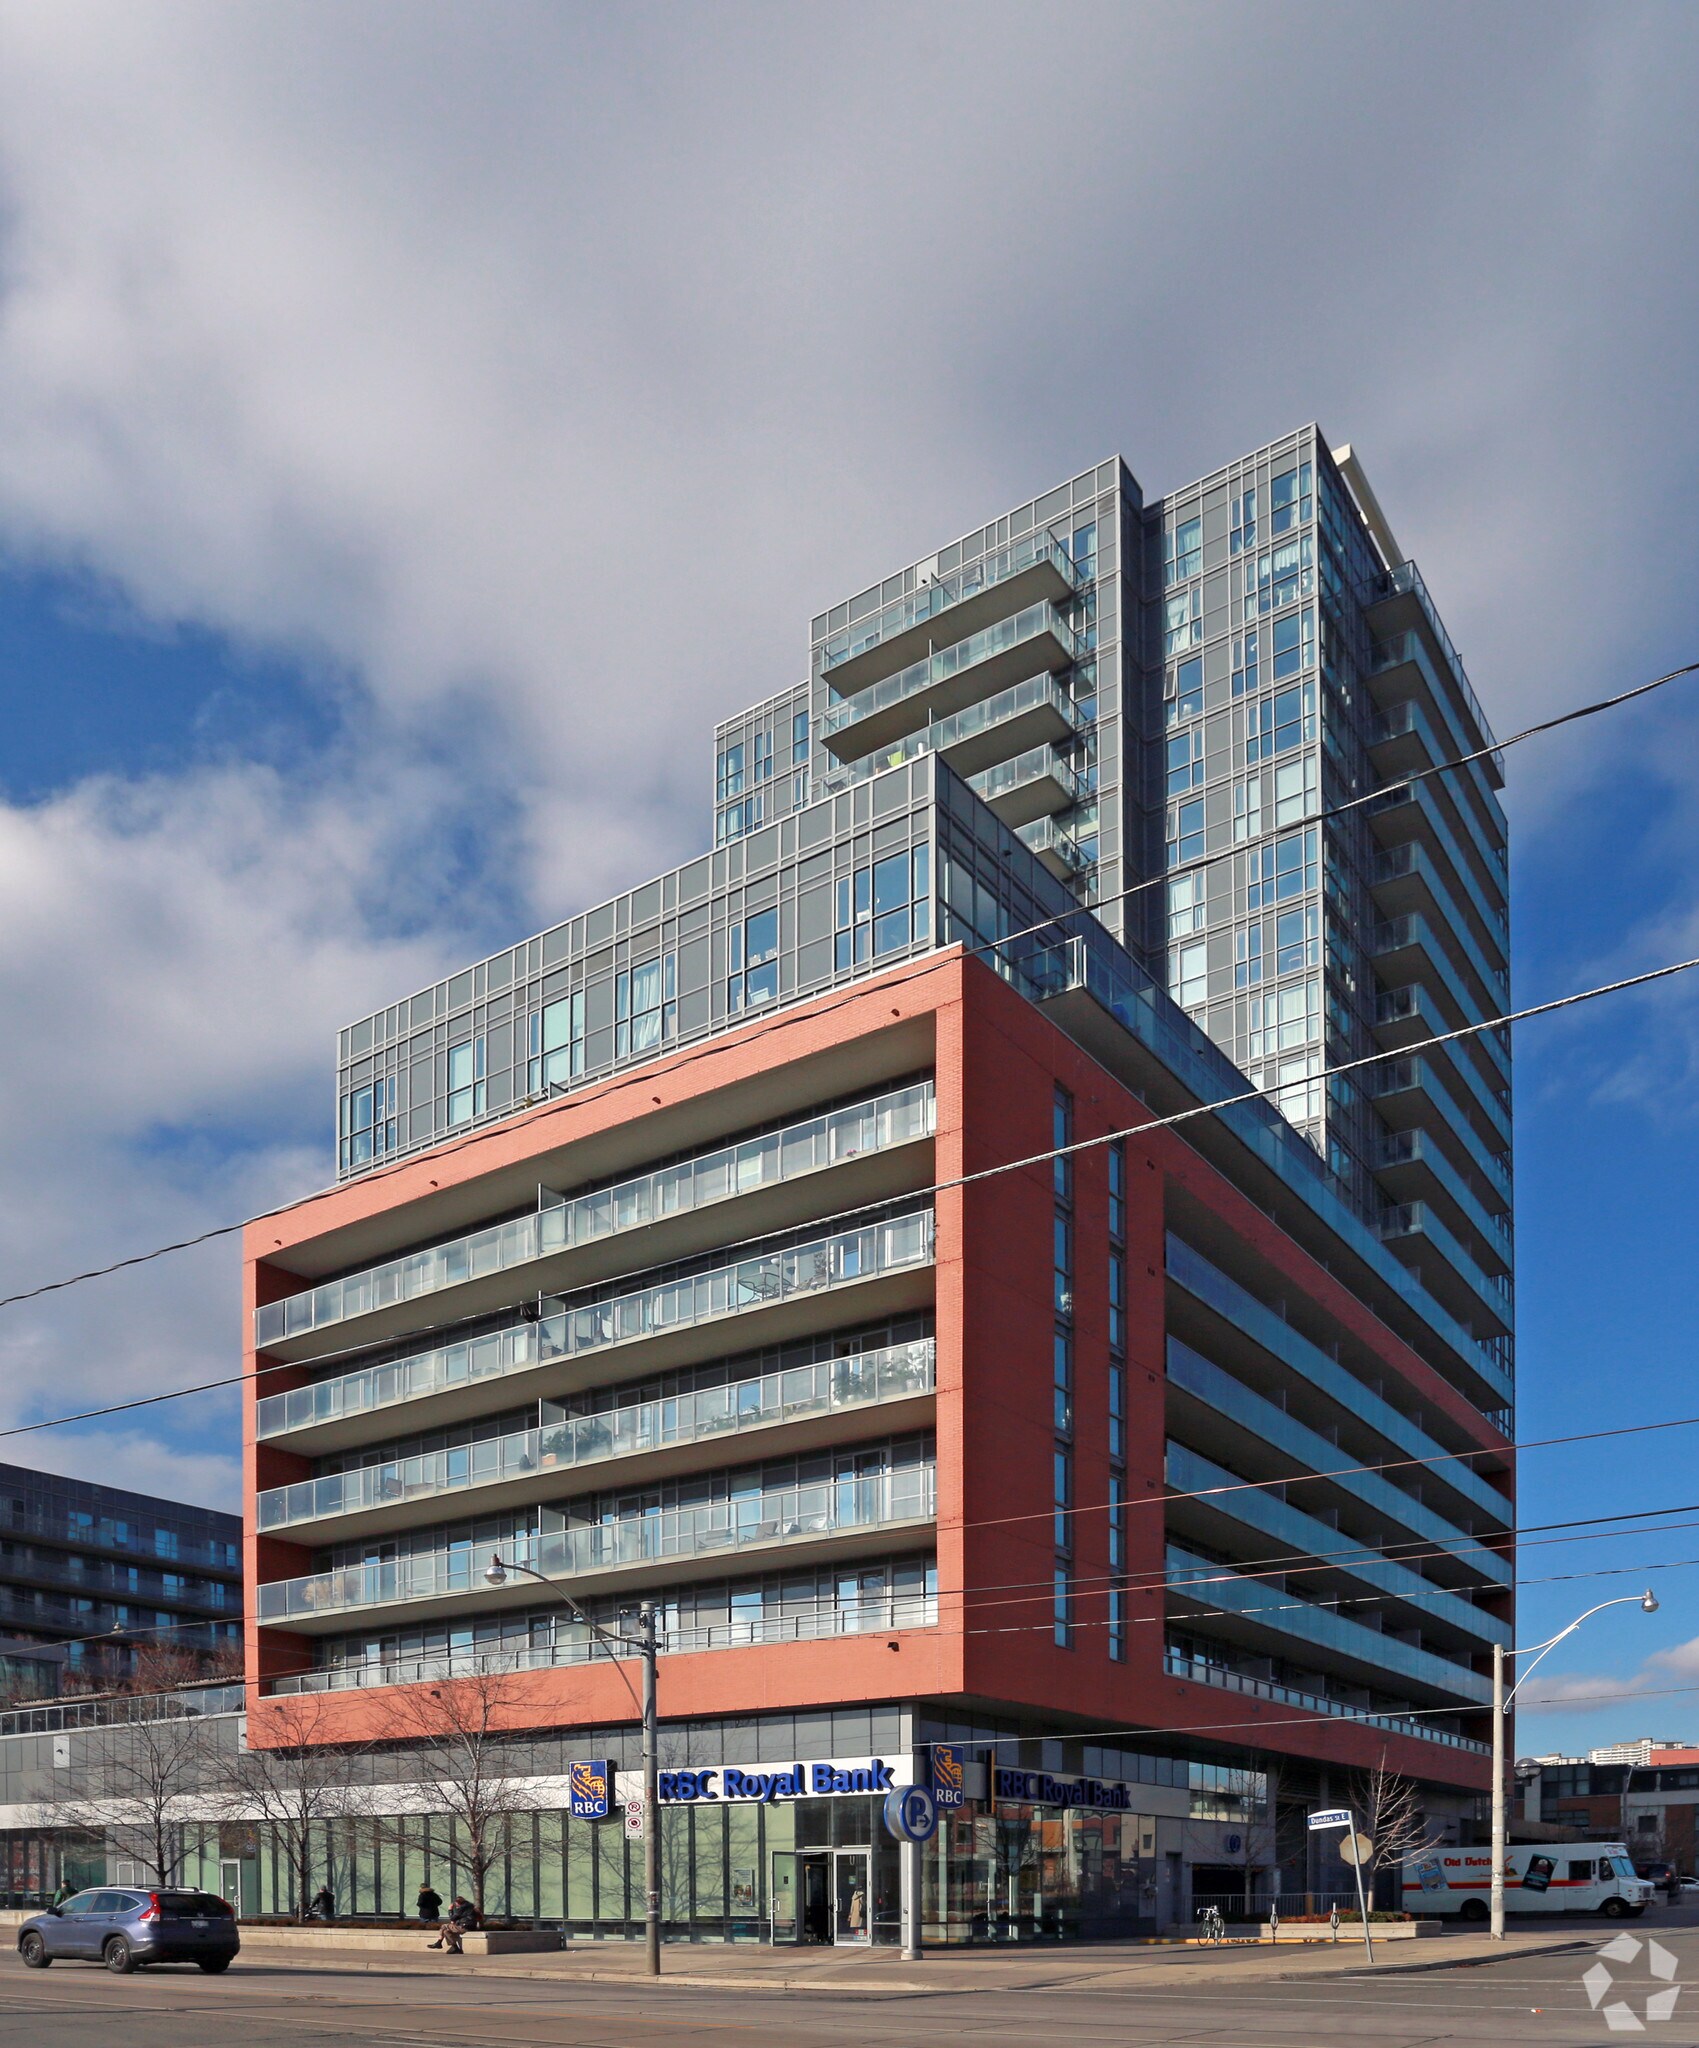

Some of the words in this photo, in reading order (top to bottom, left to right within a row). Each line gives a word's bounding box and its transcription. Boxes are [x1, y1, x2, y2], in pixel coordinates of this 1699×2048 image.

[659, 1770, 718, 1801] RBC
[723, 1763, 804, 1803] Royal
[812, 1759, 895, 1793] Bank
[1000, 1769, 1039, 1800] RBC
[1042, 1774, 1089, 1807] Royal
[1093, 1781, 1131, 1808] Bank
[936, 1788, 961, 1804] RBC
[574, 1801, 604, 1814] RBC
[1311, 1815, 1333, 1825] Dundas
[1444, 1857, 1461, 1867] Old
